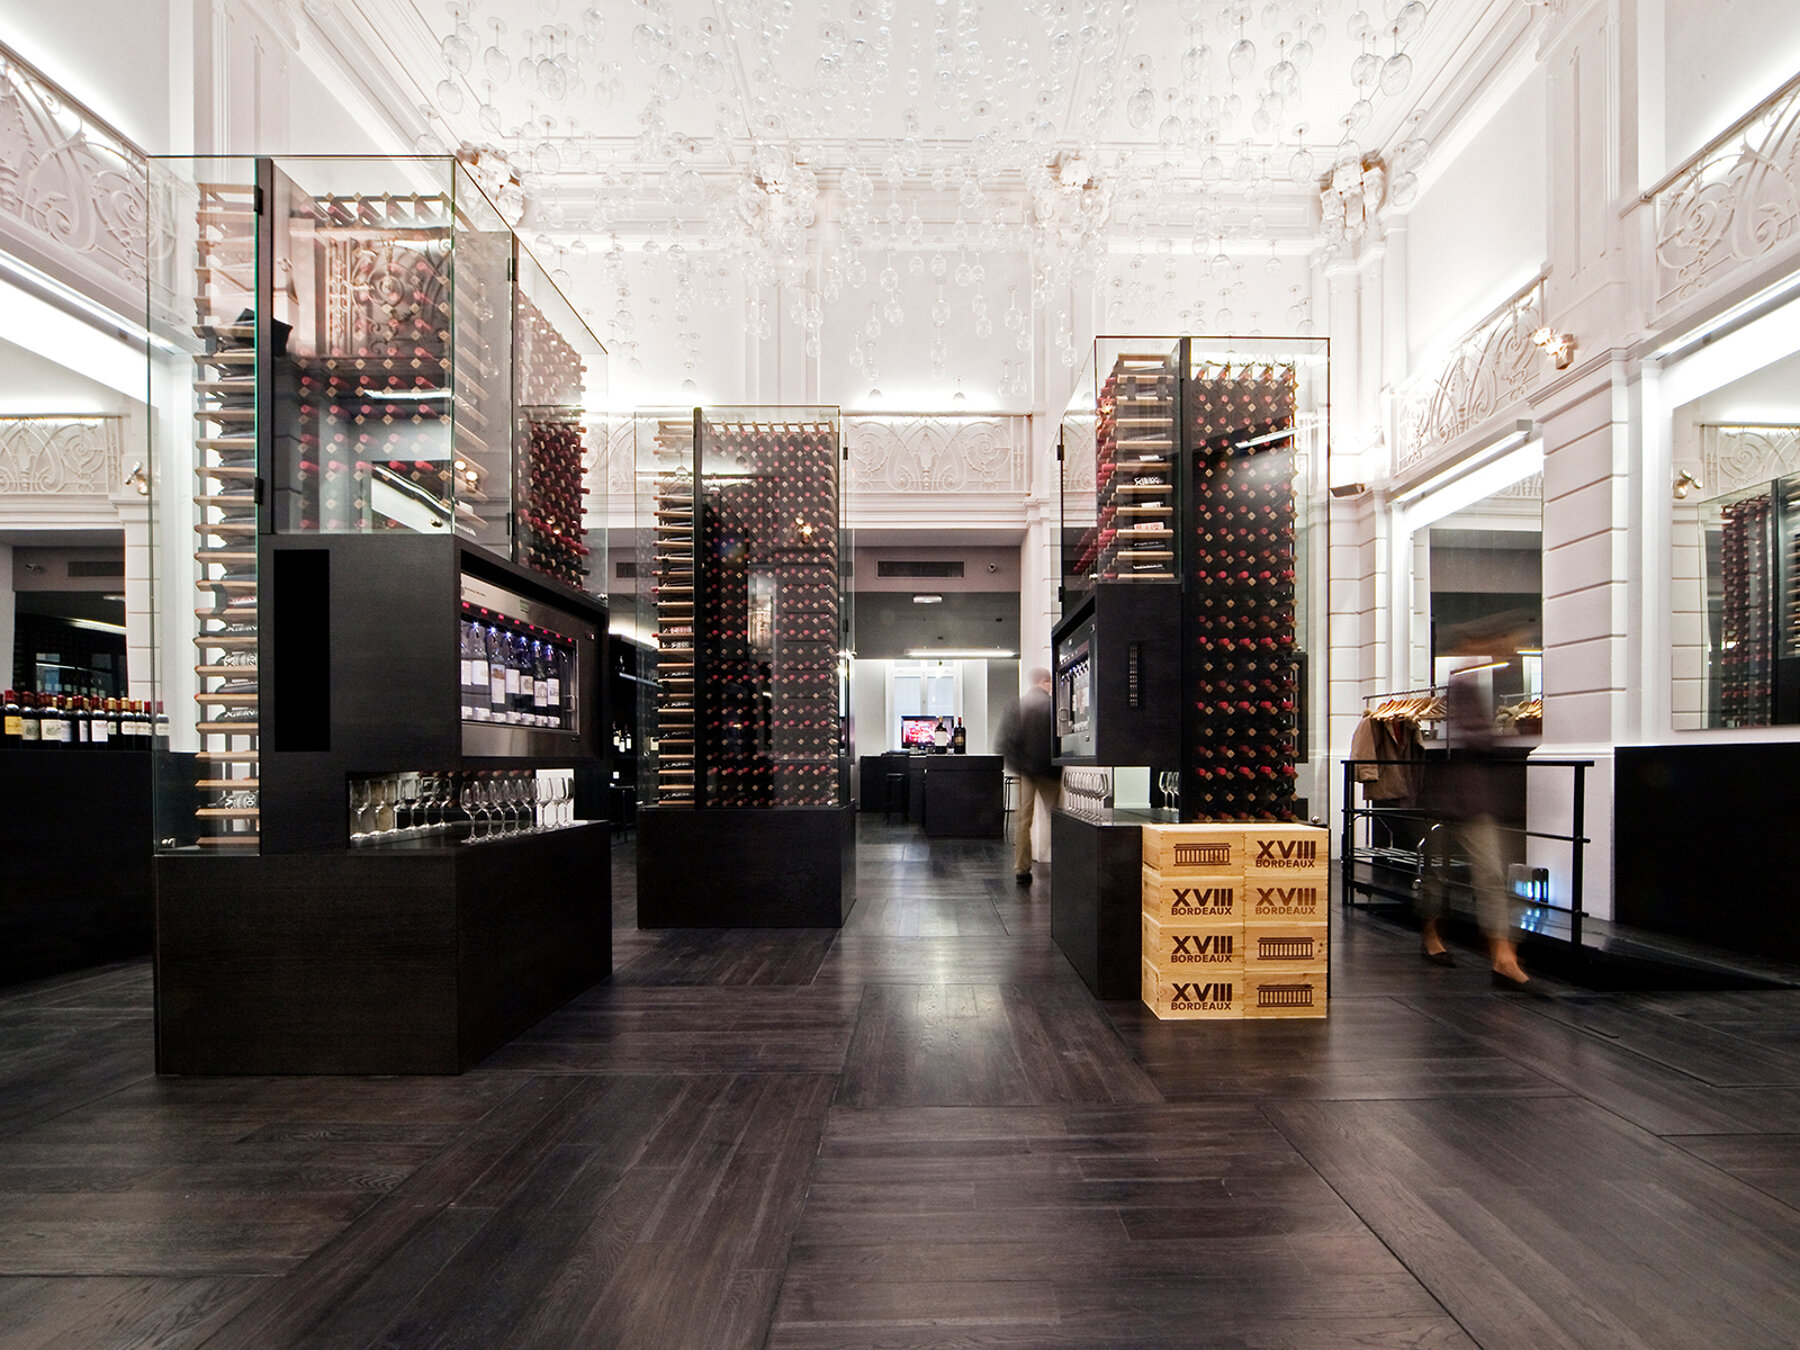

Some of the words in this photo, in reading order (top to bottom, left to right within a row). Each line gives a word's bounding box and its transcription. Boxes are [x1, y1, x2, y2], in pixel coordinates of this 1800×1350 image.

[1257, 840, 1316, 859] XVIII
[1256, 859, 1315, 868] BORDEAUX
[1172, 888, 1233, 907] XVIII
[1256, 888, 1316, 906] XVIII
[1171, 907, 1232, 916] BORDEAUX
[1256, 907, 1316, 915] BORDEAUX
[1172, 936, 1233, 954] XVIII
[1171, 954, 1232, 963] BORDEAUX
[1172, 983, 1233, 1001] XVIII
[1171, 1002, 1232, 1010] BORDEAUX
